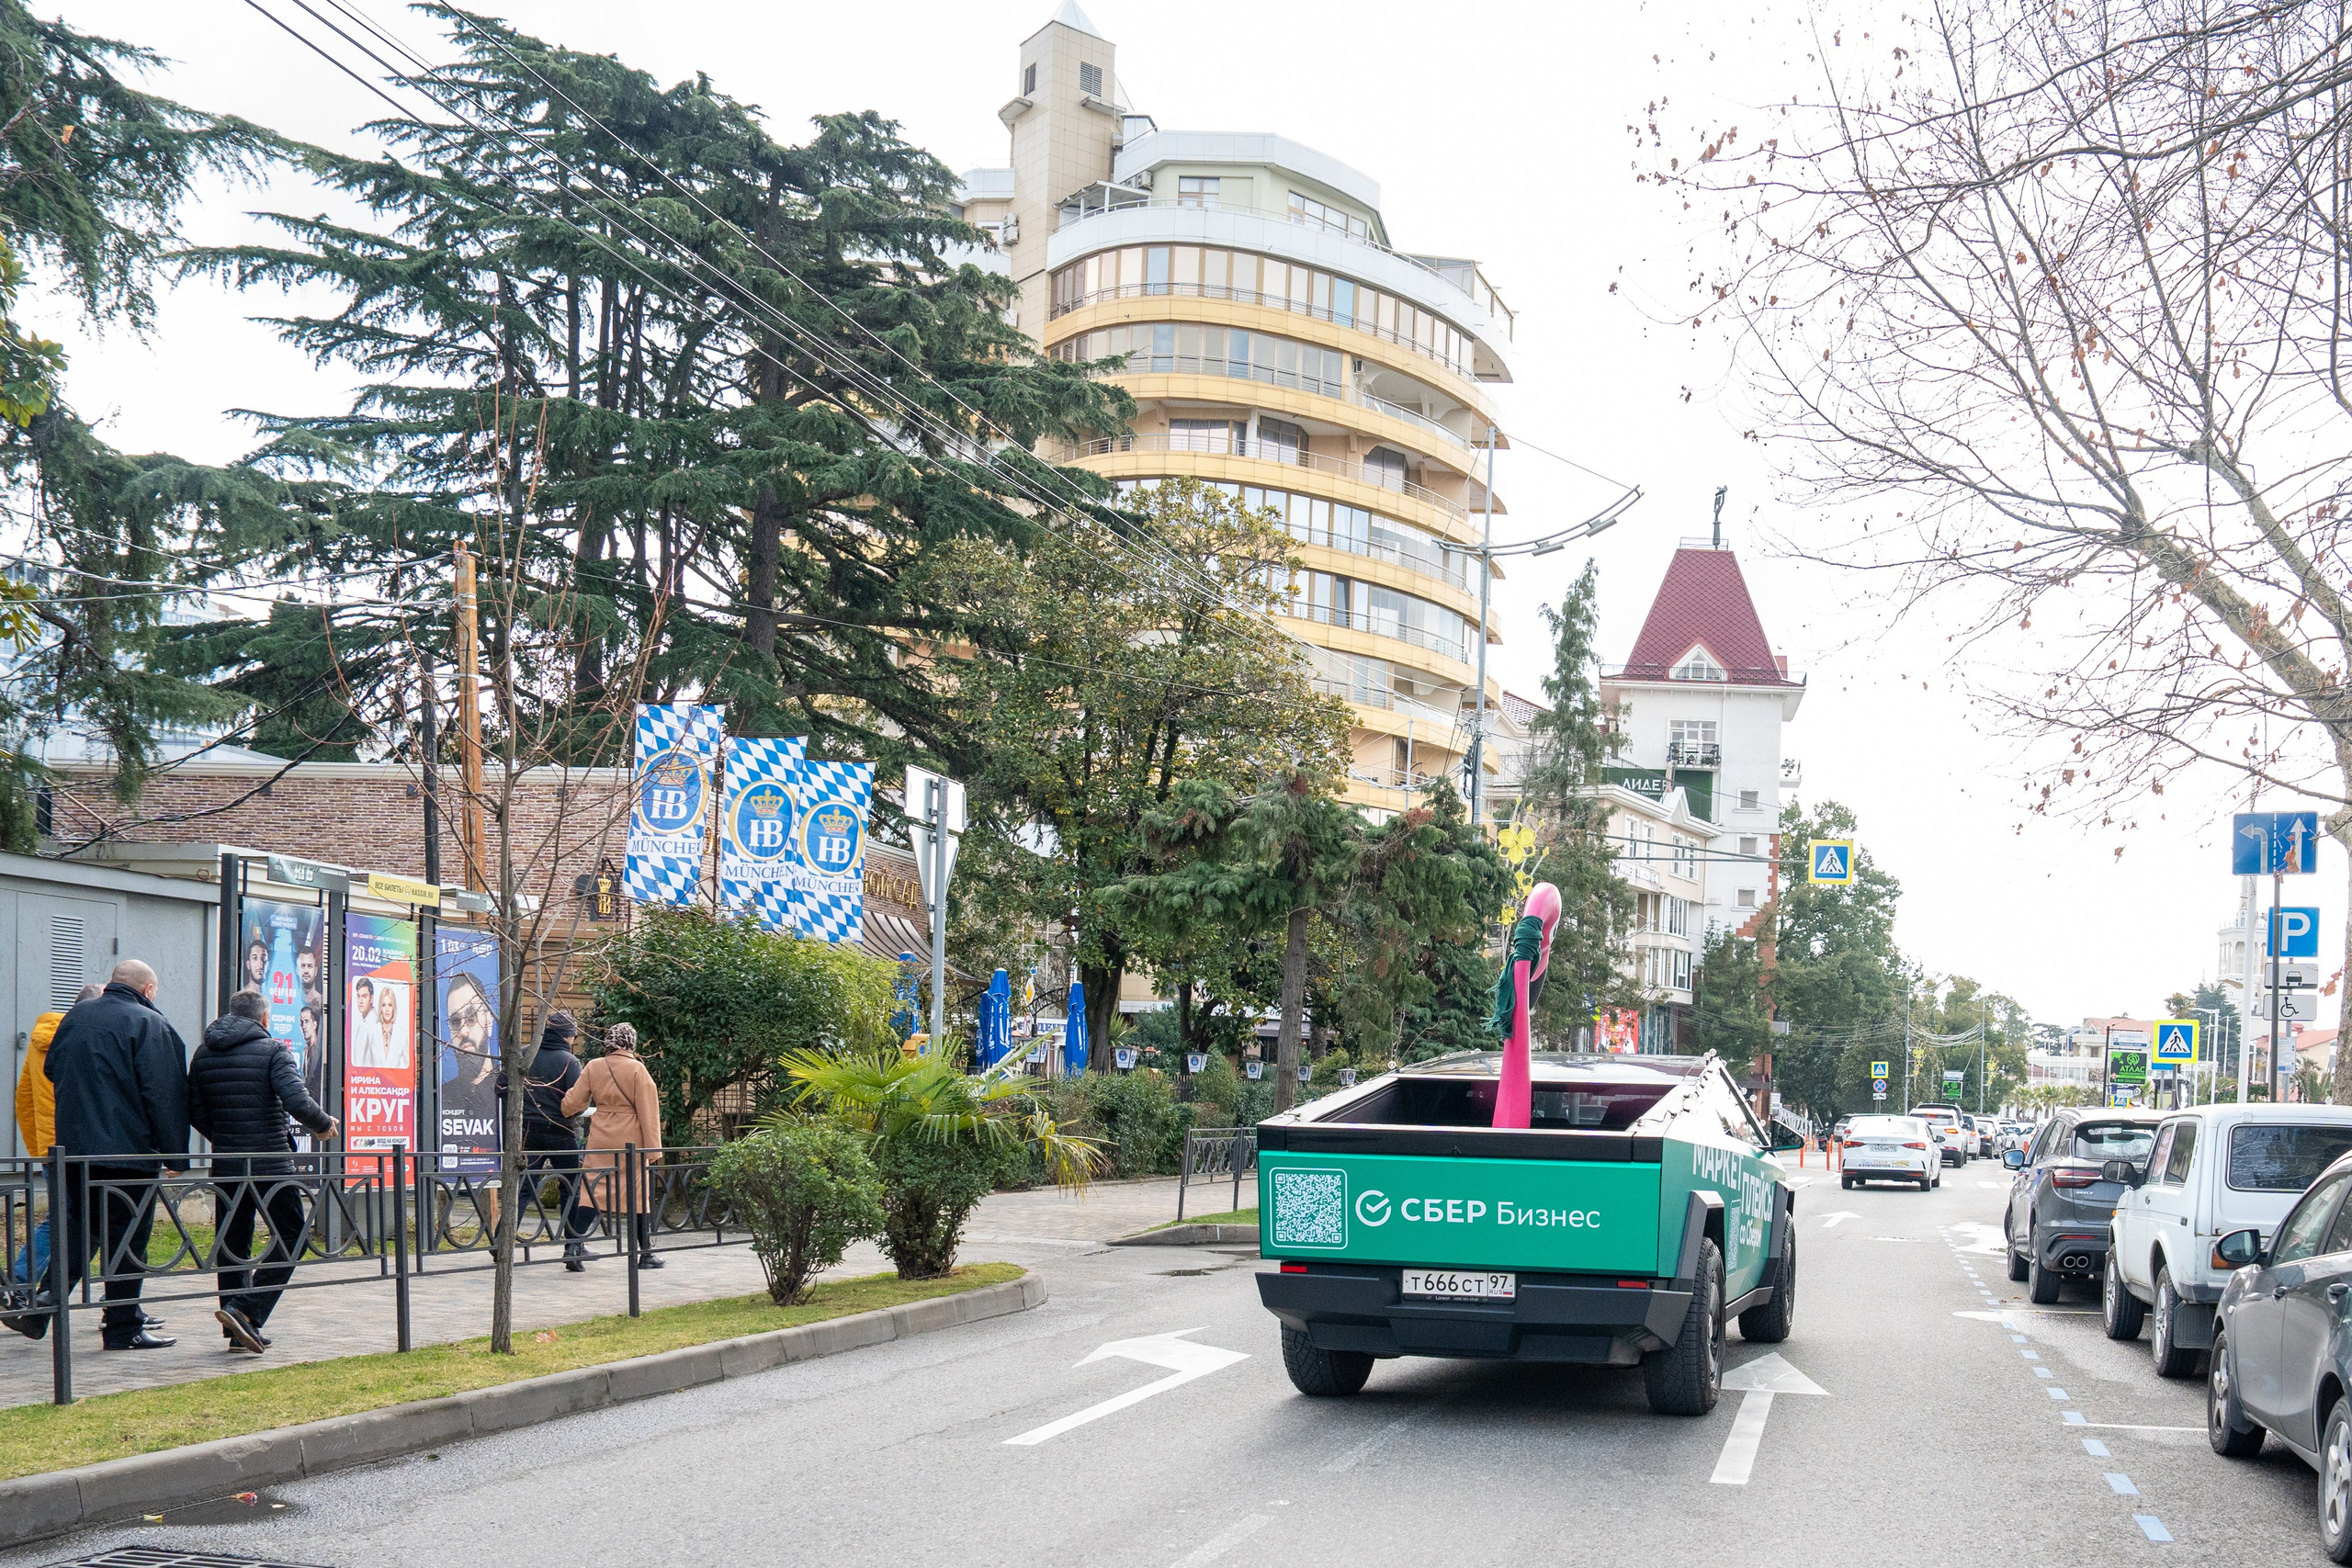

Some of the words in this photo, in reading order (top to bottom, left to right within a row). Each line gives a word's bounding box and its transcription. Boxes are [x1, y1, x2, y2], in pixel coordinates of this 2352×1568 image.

[650, 789, 687, 820] HB
[749, 819, 783, 847] HB
[818, 836, 851, 864] HB
[725, 863, 795, 878] MÜNCHEN
[375, 882, 383, 890] ВСЕ
[384, 884, 403, 893] БИЛЕТЫ
[412, 889, 434, 898] KASSIR.RU
[892, 876, 919, 909] САД
[2280, 912, 2311, 952] P
[353, 945, 380, 963] 20.02
[269, 987, 297, 998] ФЕВРАЛЯ
[273, 971, 293, 1004] 21
[271, 1014, 295, 1023] СОЧИ
[351, 1076, 381, 1084] ИРИНА
[358, 1087, 410, 1096] АЛЕКСАНДР
[350, 1098, 410, 1122] КРУГ
[442, 1118, 494, 1135] SEVAK
[1693, 1144, 1744, 1191] МАРКЕТ
[1401, 1198, 1487, 1224] СБЕР
[1498, 1201, 1600, 1228] Бизнес
[1489, 1275, 1508, 1289] 97
